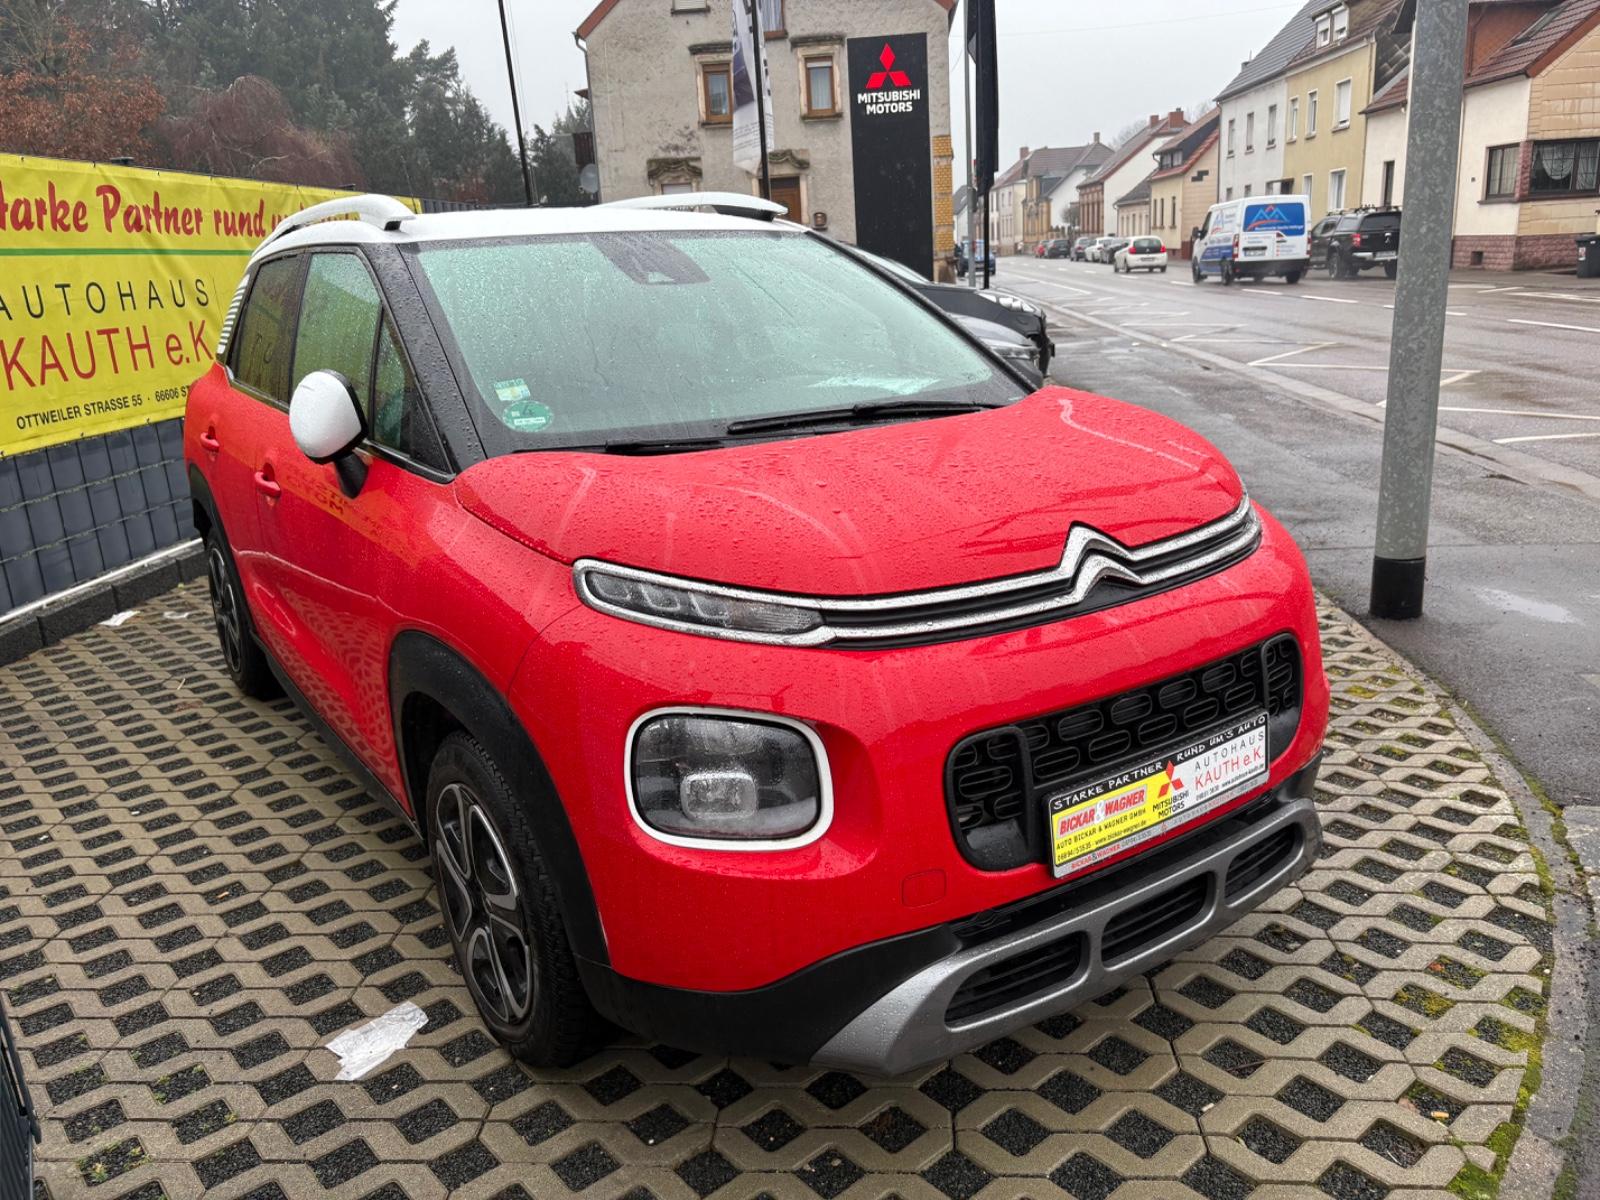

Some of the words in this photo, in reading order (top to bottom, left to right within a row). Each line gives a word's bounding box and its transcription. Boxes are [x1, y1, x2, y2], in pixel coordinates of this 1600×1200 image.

[857, 88, 921, 105] MITSUBISHI
[866, 101, 913, 115] MOTORS
[96, 184, 203, 235] Partner
[213, 198, 266, 237] rund
[0, 325, 155, 391] KAUTH
[16, 407, 82, 430] OTTWEILER
[86, 396, 129, 415] STRASSE
[132, 394, 143, 406] 55
[155, 387, 179, 402] 66606
[1053, 785, 1104, 810] STARKE
[1108, 762, 1163, 789] PARTNER
[1176, 744, 1206, 762] RUND
[1237, 715, 1265, 734] AUTO
[1194, 730, 1265, 771] AUTOHAUS
[1194, 757, 1239, 791] KAUTH
[1152, 790, 1190, 813] MITSUBISHI
[1158, 801, 1185, 819] MOTORS
[1056, 838, 1072, 850] AUTO
[1074, 828, 1096, 843] BICKAR
[1104, 815, 1128, 829] WAGNER
